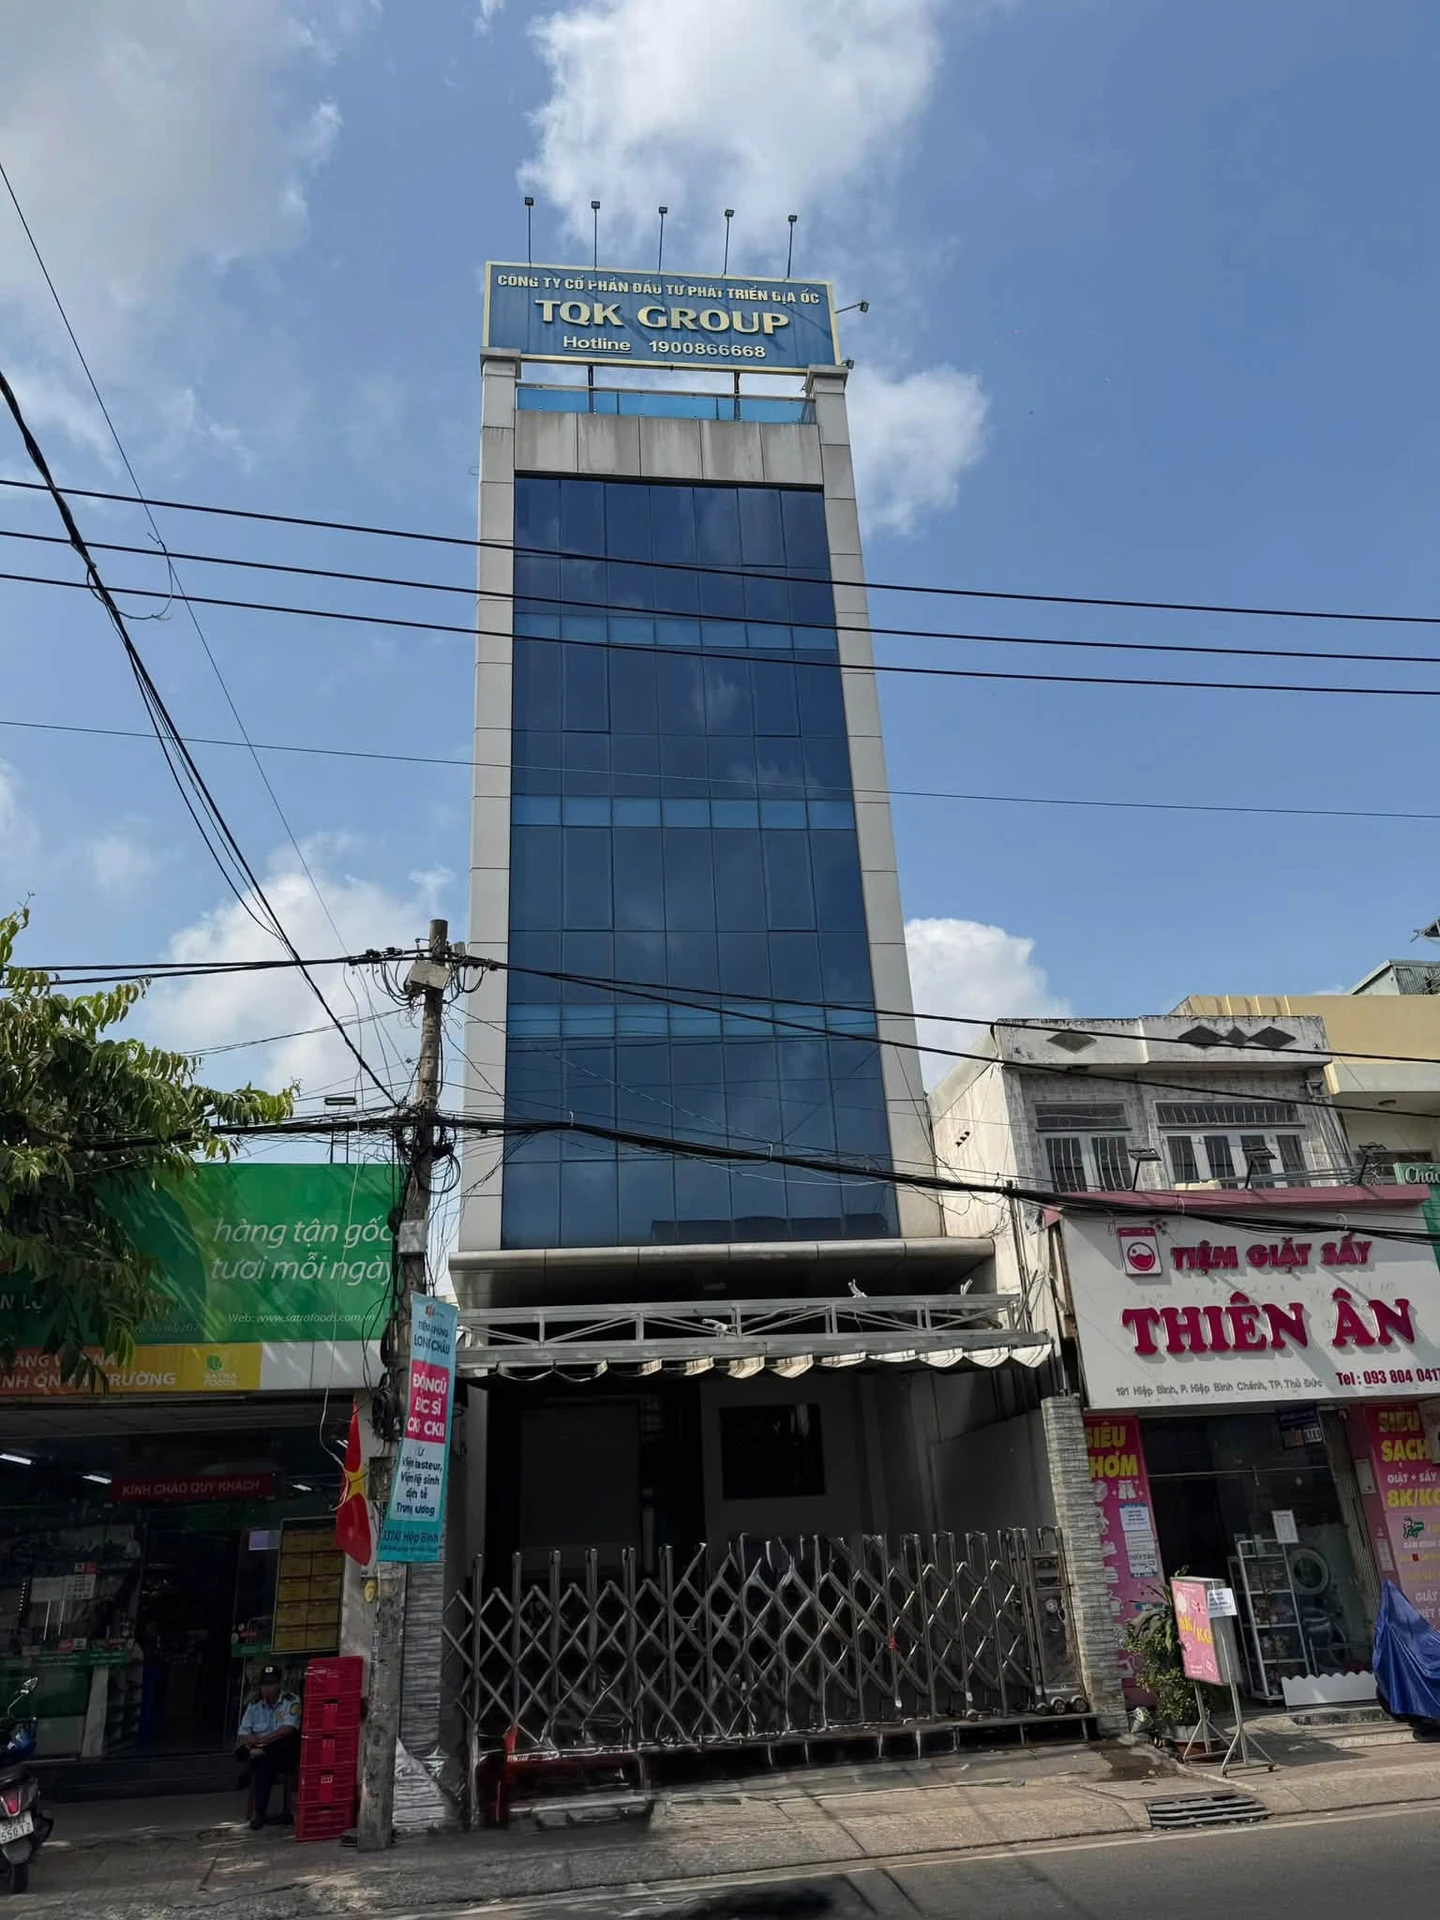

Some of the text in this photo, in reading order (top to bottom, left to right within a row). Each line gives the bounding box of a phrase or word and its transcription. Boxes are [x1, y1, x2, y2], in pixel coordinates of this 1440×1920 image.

[497, 273, 539, 288] CÔNG
[543, 277, 561, 289] TY
[535, 299, 789, 335] TQK GROUP
[563, 335, 766, 358] Hotline 1900866668
[213, 1216, 288, 1249] hàng
[293, 1217, 338, 1248] tận
[271, 1251, 327, 1281] mỗi
[1170, 1231, 1372, 1275] TIỆM GIẶT SẤY
[1122, 1286, 1415, 1356] THIÊN ÂN
[1363, 1370, 1387, 1385] 093
[1389, 1369, 1413, 1384] 804
